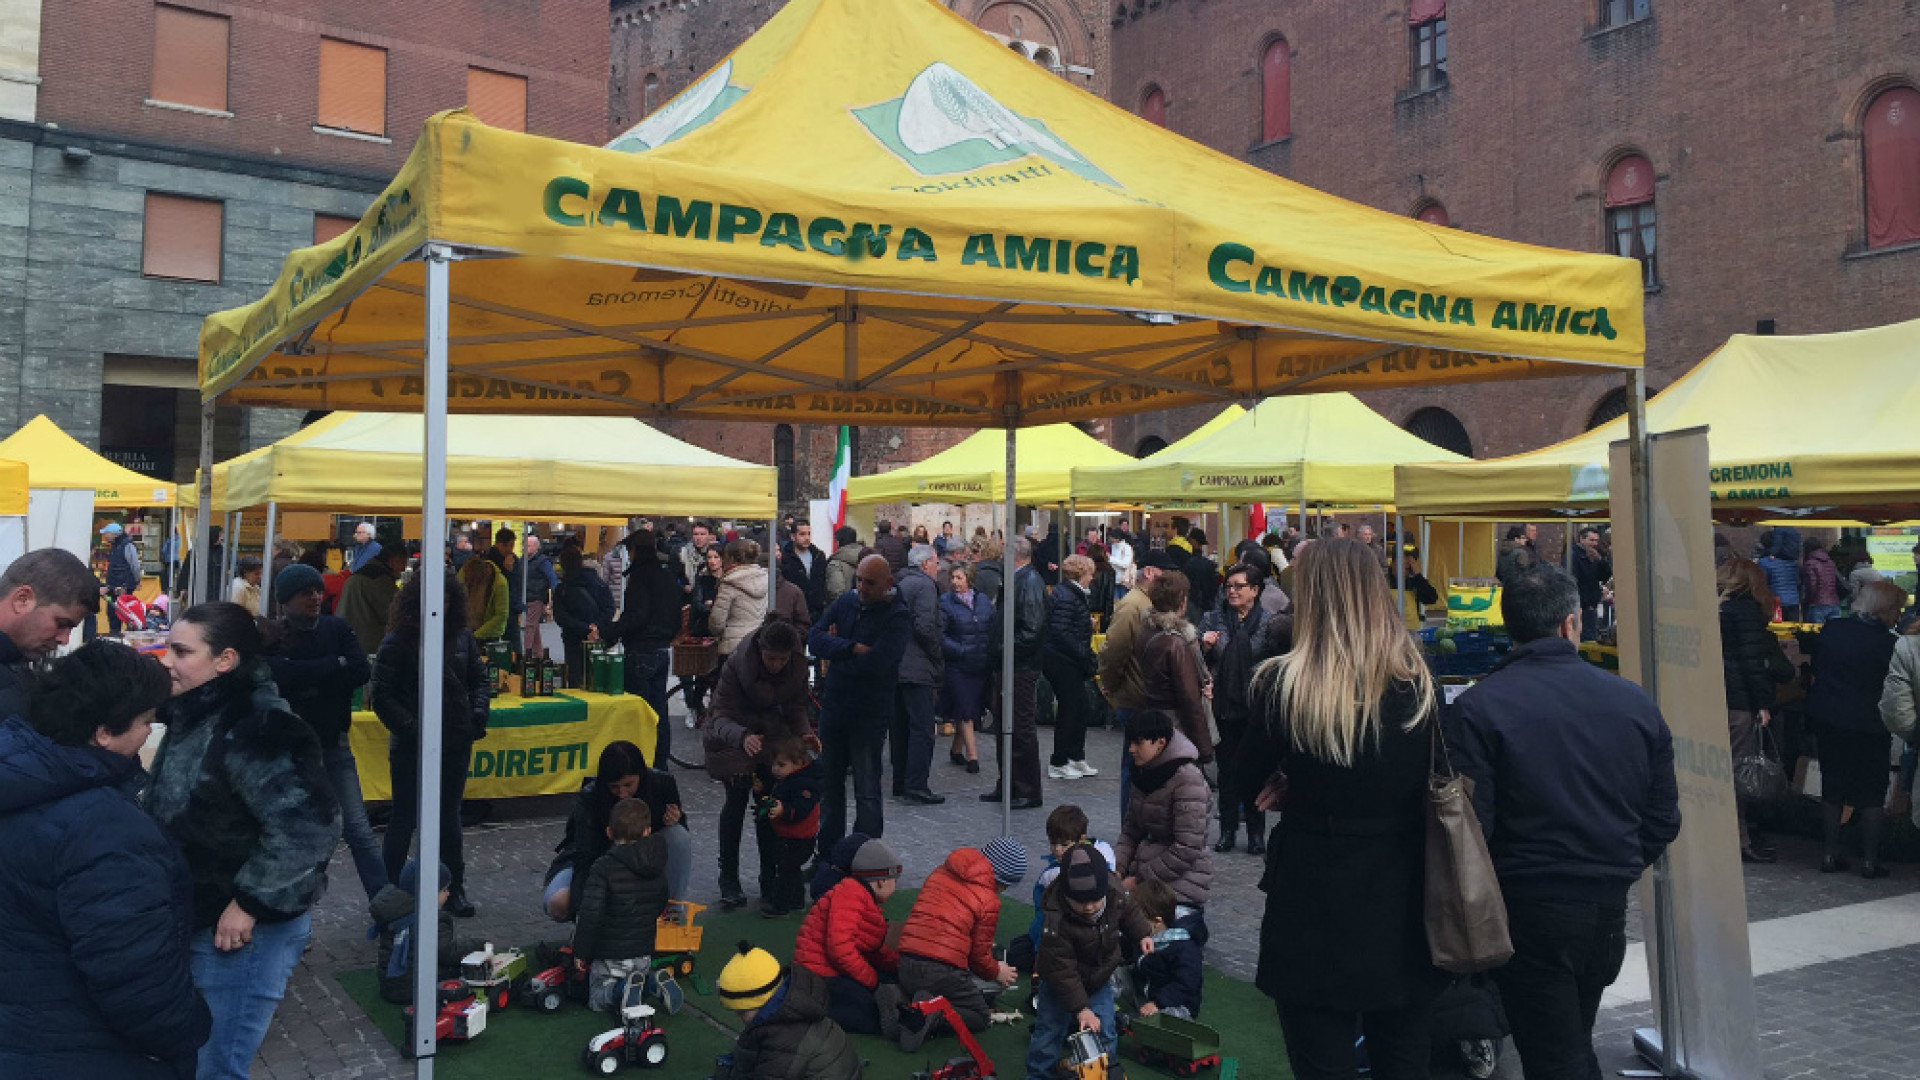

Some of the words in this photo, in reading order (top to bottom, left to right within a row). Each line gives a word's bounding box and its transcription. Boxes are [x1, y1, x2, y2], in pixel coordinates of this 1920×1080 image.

[543, 176, 937, 262] CAMPAGNA
[961, 233, 1140, 287] AMICA
[1208, 241, 1476, 327] CAMPAGNA
[1492, 301, 1618, 340] AMICA
[1710, 461, 1794, 483] CREMONA
